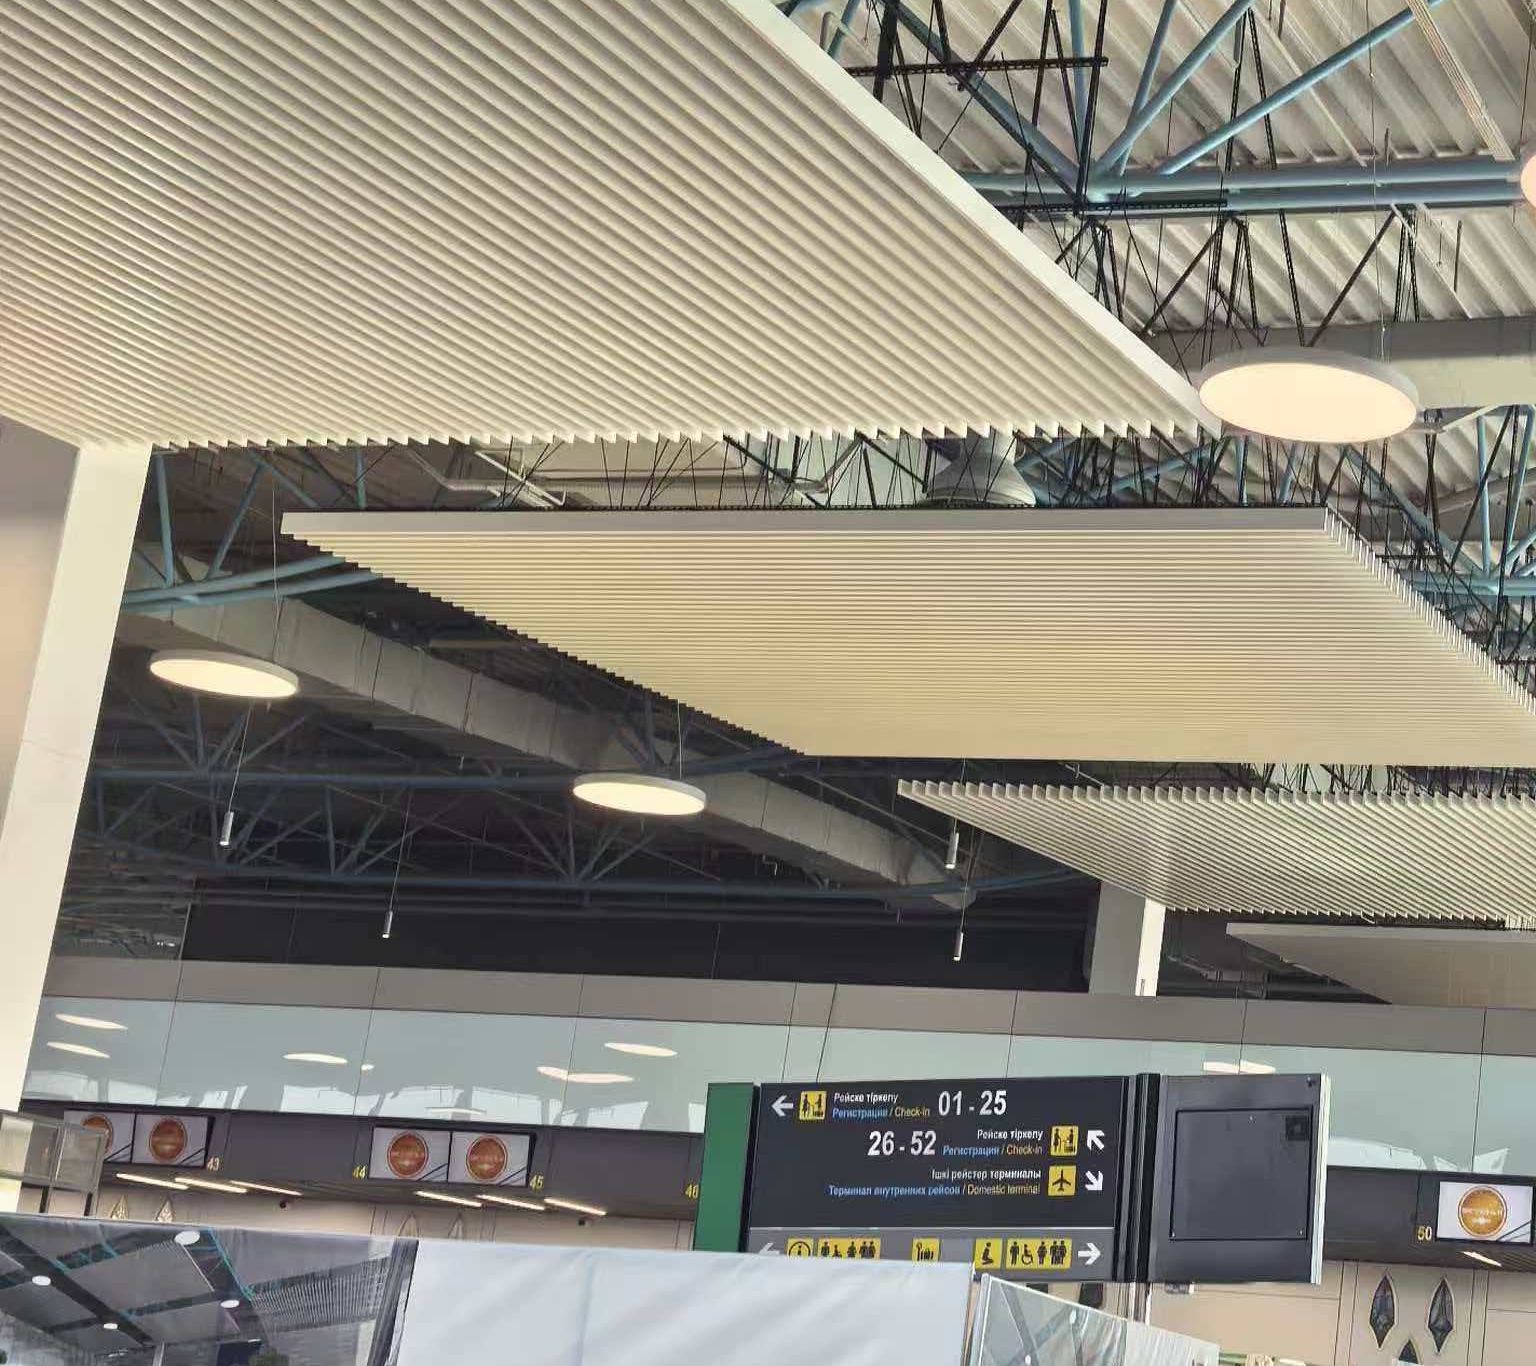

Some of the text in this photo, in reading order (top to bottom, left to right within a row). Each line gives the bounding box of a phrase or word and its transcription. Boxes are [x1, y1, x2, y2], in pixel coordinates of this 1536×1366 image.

[938, 1091, 962, 1116] 01
[979, 1090, 1007, 1115] 25
[894, 1107, 930, 1117] Check-in
[867, 1131, 894, 1156] 26
[911, 1131, 937, 1156] 52
[1006, 1145, 1043, 1155] Check-in
[207, 1157, 219, 1171] 43
[352, 1164, 367, 1179] 44
[529, 1175, 543, 1190] 45
[967, 1183, 1005, 1195] Domestic
[1417, 1227, 1433, 1241] 50
